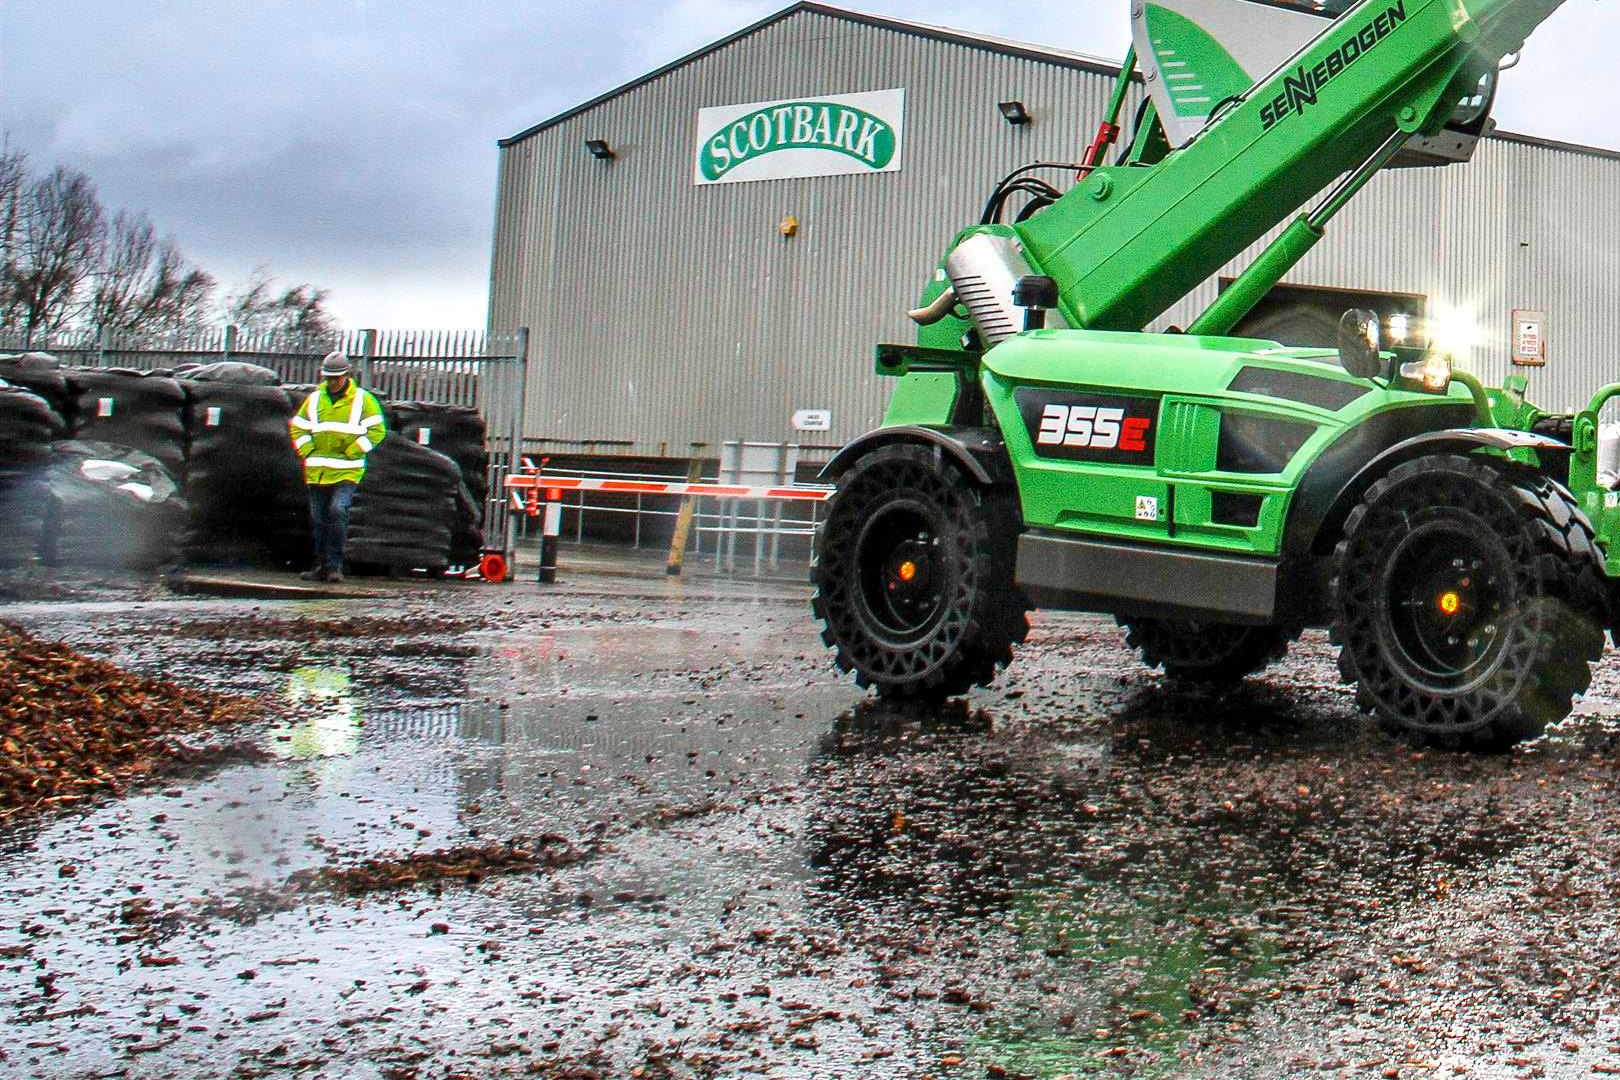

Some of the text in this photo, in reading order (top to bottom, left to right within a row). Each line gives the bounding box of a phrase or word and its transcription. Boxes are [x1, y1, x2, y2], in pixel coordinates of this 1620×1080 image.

[1259, 0, 1407, 130] SENNEBOGEN
[710, 105, 884, 173] SCOTBARK
[1037, 404, 1152, 451] 355E
